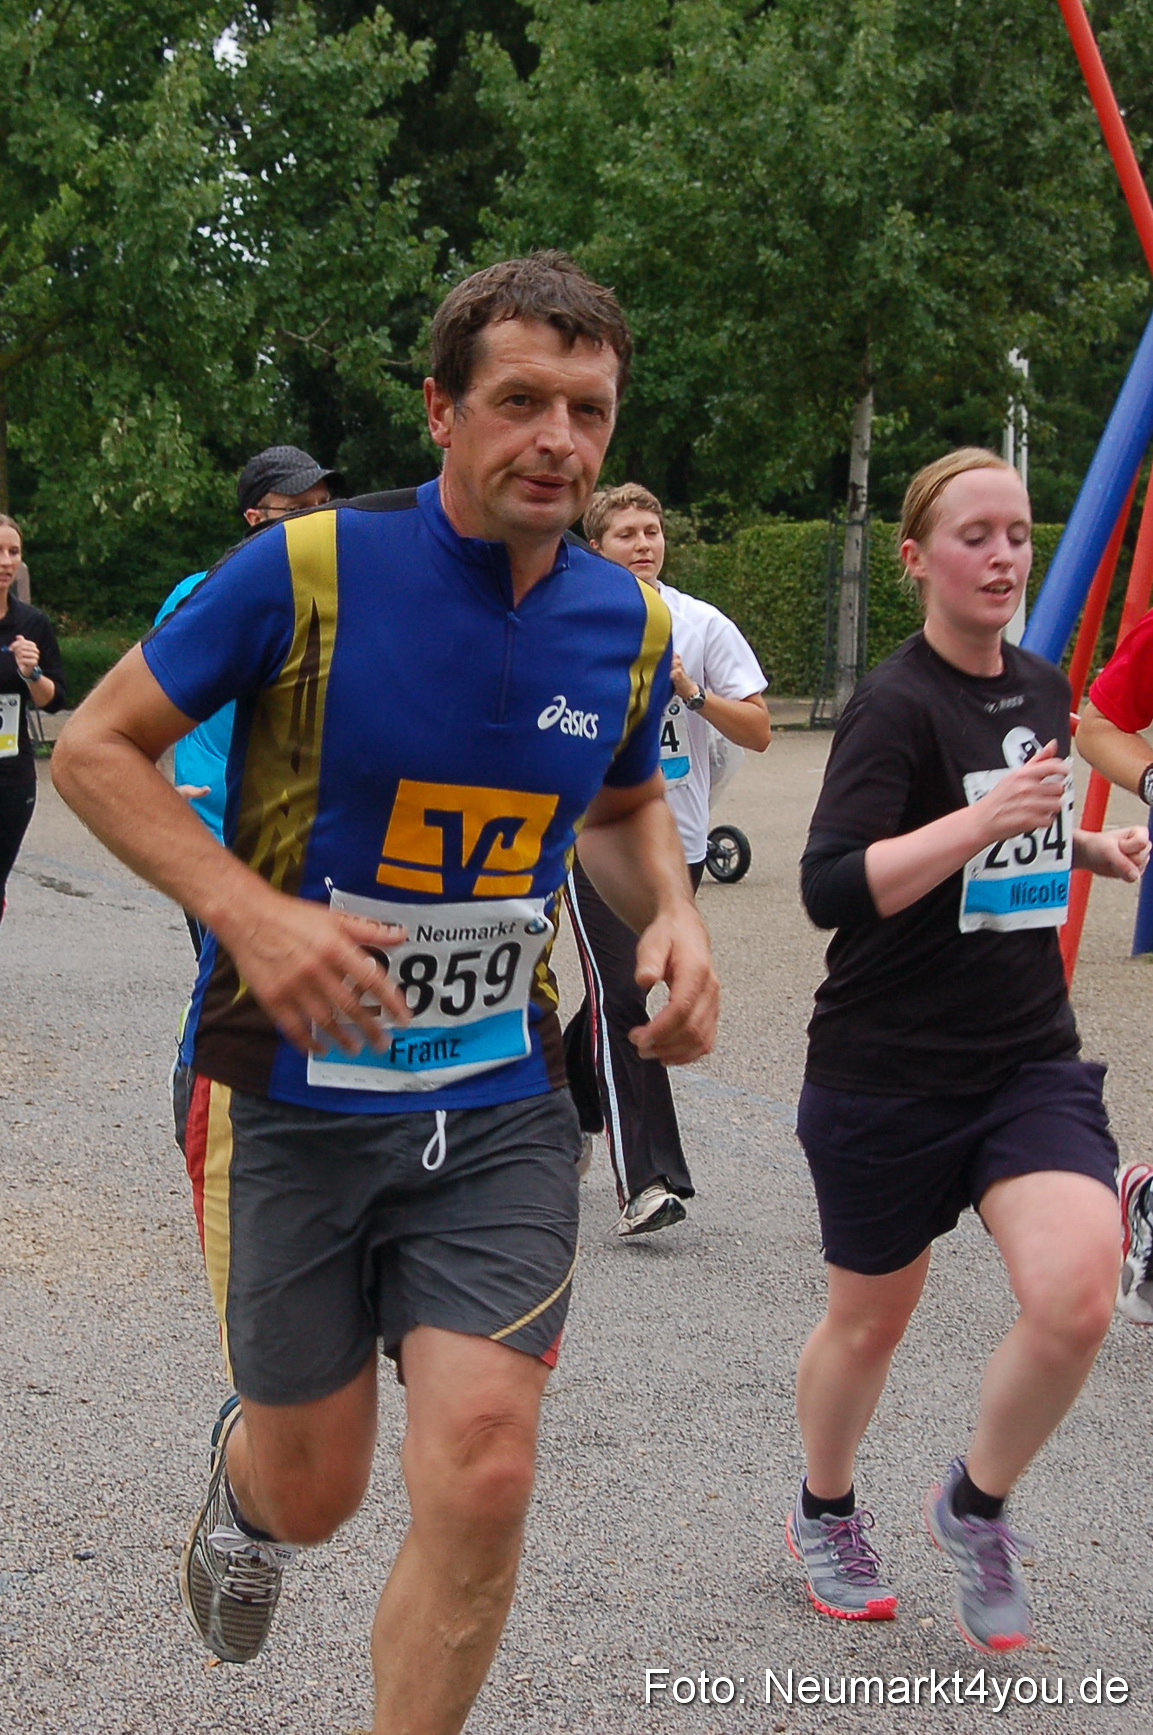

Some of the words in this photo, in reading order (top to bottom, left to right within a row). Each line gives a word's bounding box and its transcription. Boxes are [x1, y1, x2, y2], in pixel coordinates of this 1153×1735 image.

[1010, 879, 1067, 907] Nicole
[416, 922, 516, 943] Neumarkt
[389, 1036, 461, 1064] Franz
